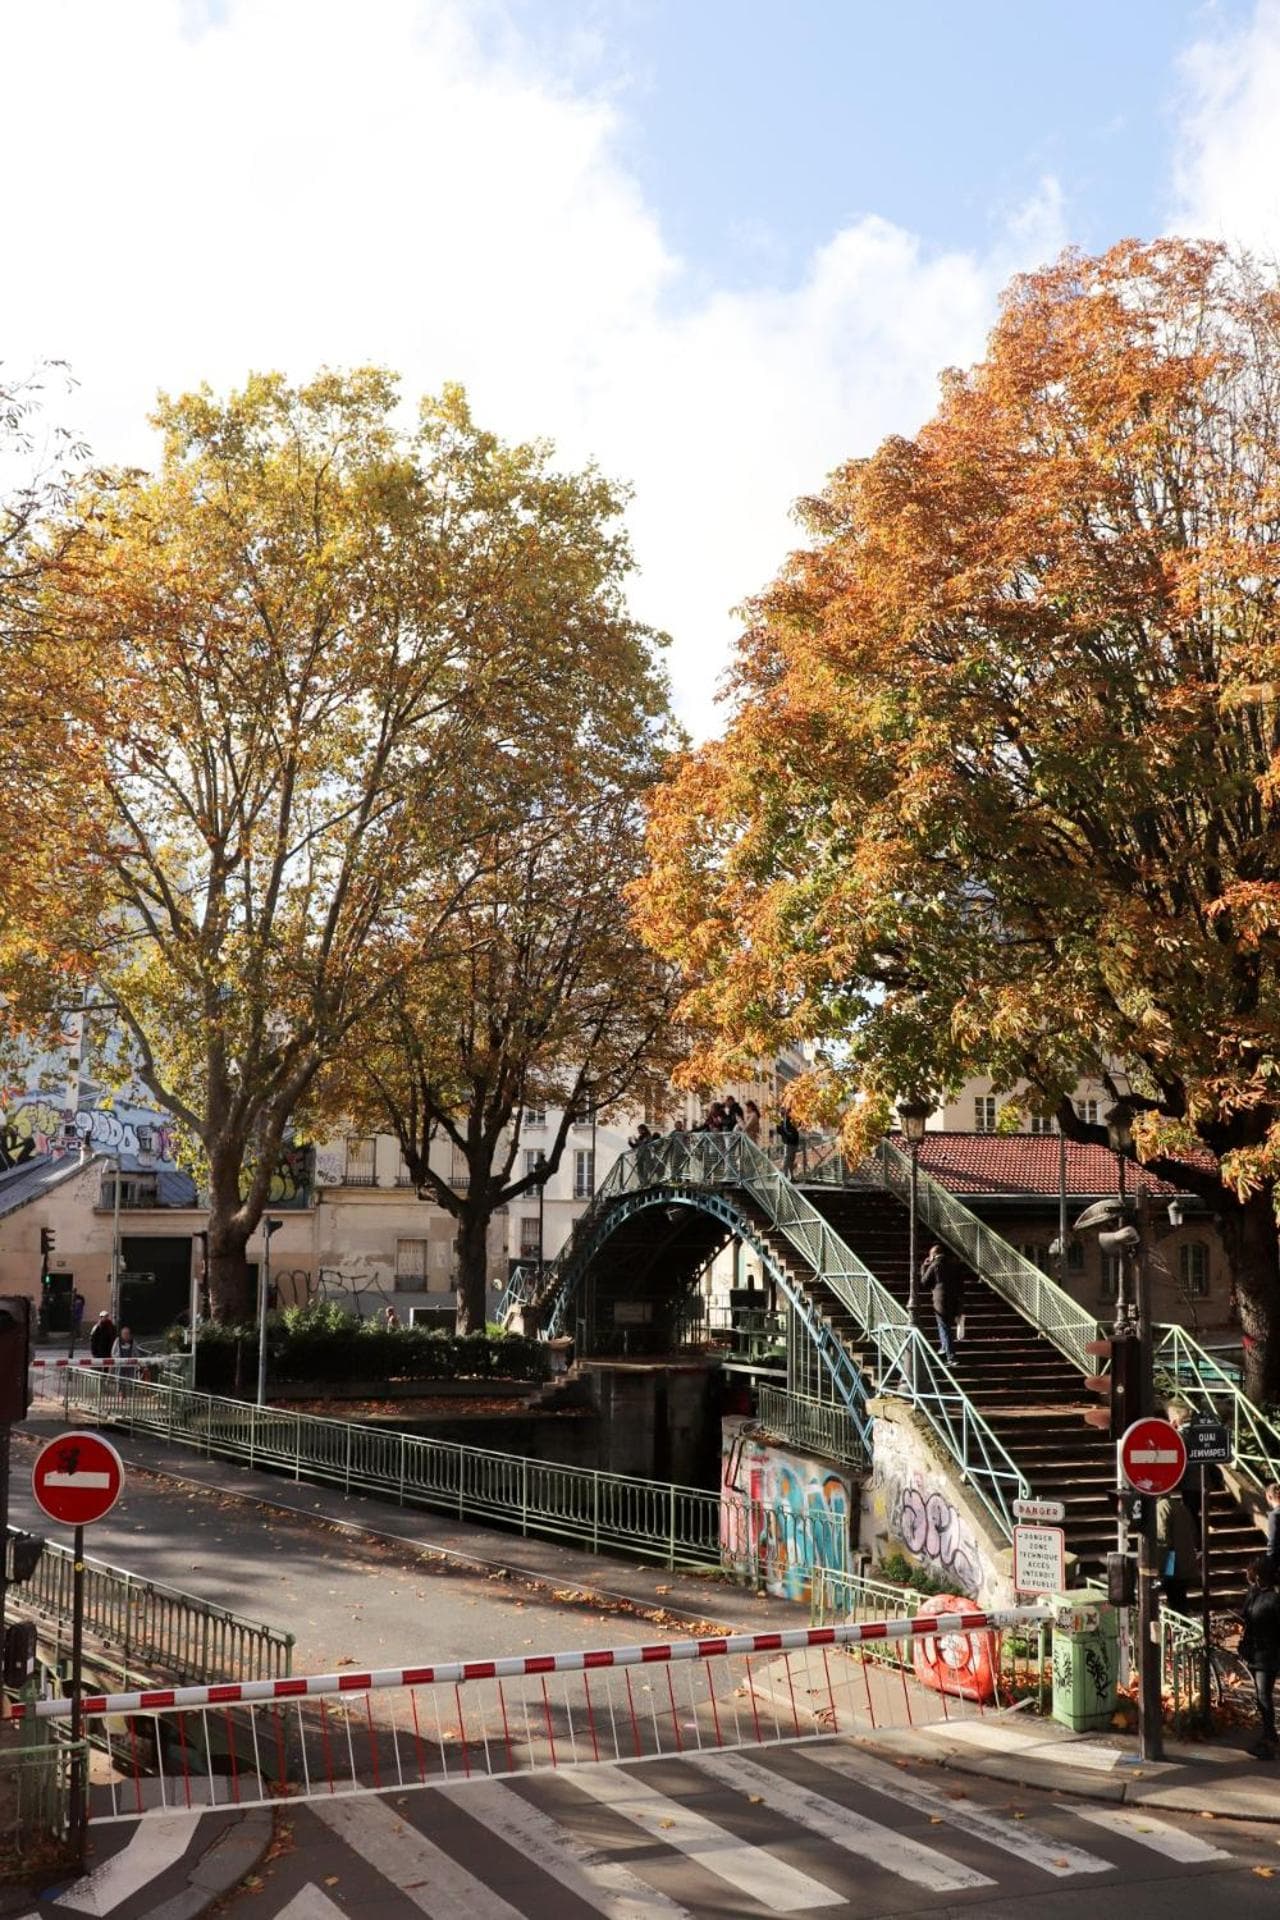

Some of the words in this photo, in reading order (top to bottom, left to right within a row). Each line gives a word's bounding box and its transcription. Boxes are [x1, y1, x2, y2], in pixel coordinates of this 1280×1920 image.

[1198, 1433, 1216, 1442] QUAI
[1018, 1505, 1058, 1516] DANGER
[1029, 1543, 1048, 1551] ZONE
[1020, 1551, 1058, 1561] TECHNIQUE
